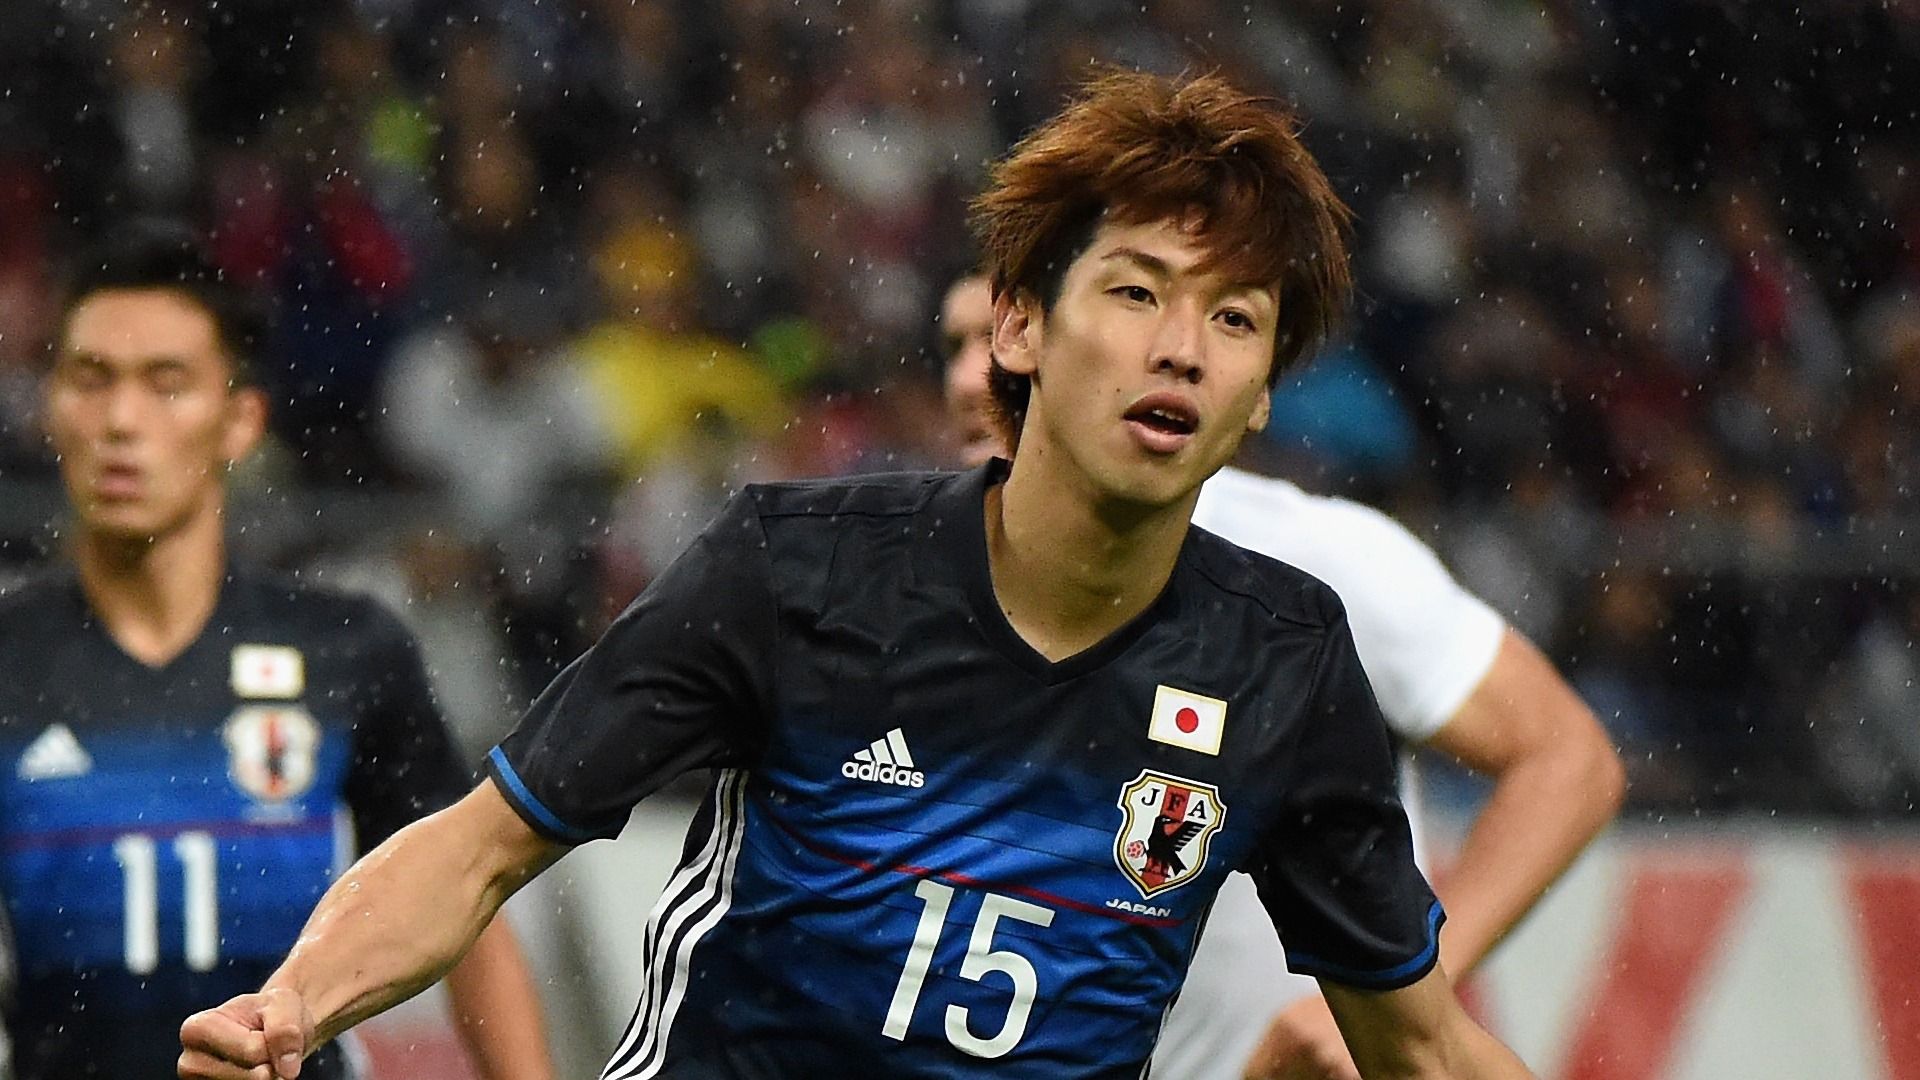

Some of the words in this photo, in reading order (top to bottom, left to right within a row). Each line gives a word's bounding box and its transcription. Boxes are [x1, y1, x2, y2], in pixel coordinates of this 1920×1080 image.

[842, 761, 924, 788] adidas
[1141, 788, 1207, 820] JFA
[115, 831, 219, 976] 11
[1105, 899, 1171, 918] JAPAN
[882, 879, 1056, 1058] 15
